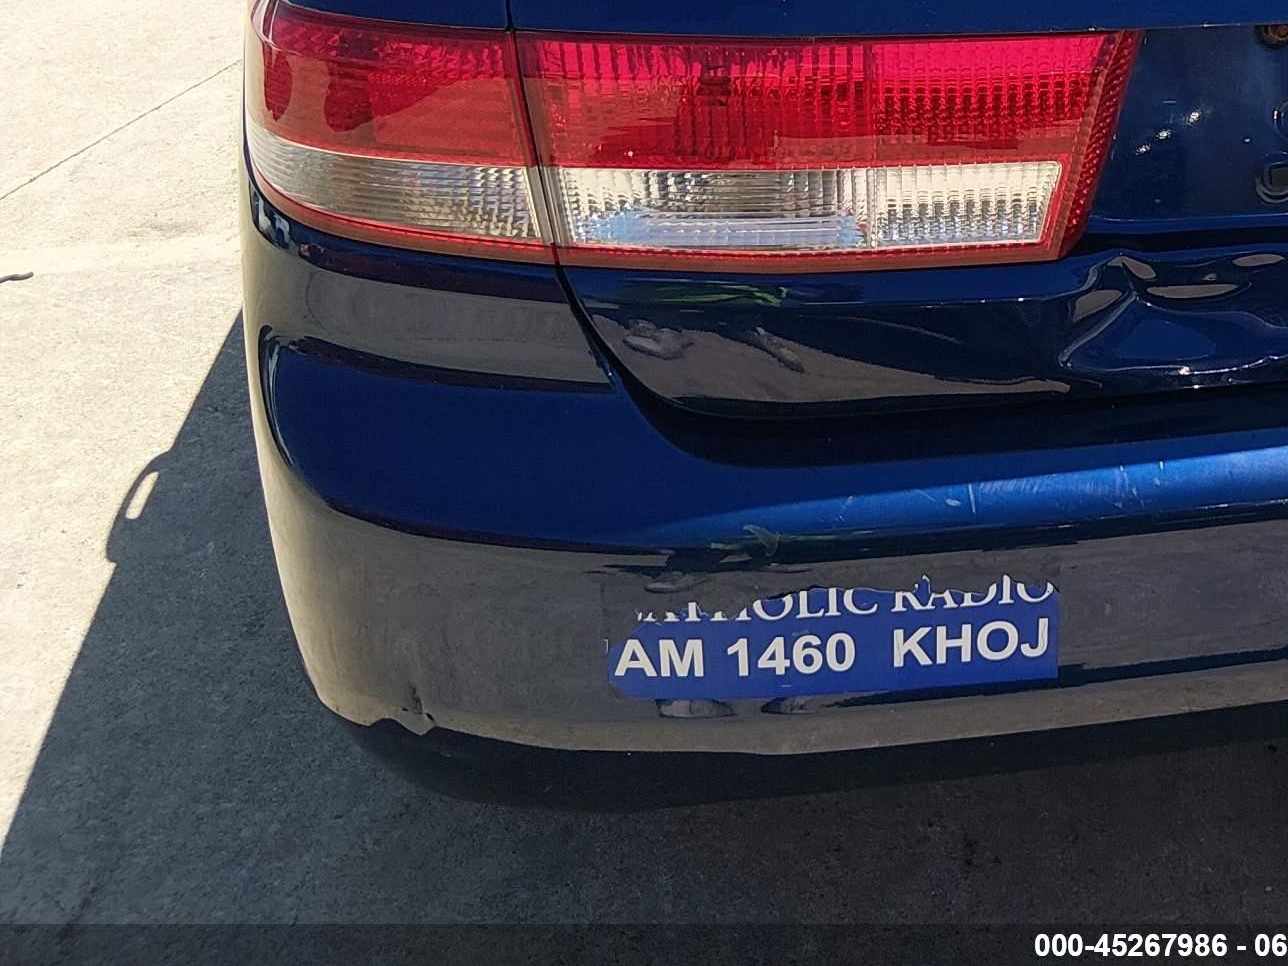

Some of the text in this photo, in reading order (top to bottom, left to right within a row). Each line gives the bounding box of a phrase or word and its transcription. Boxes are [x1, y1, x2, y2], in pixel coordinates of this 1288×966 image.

[614, 617, 1050, 677] AM 1460 KHOJ
